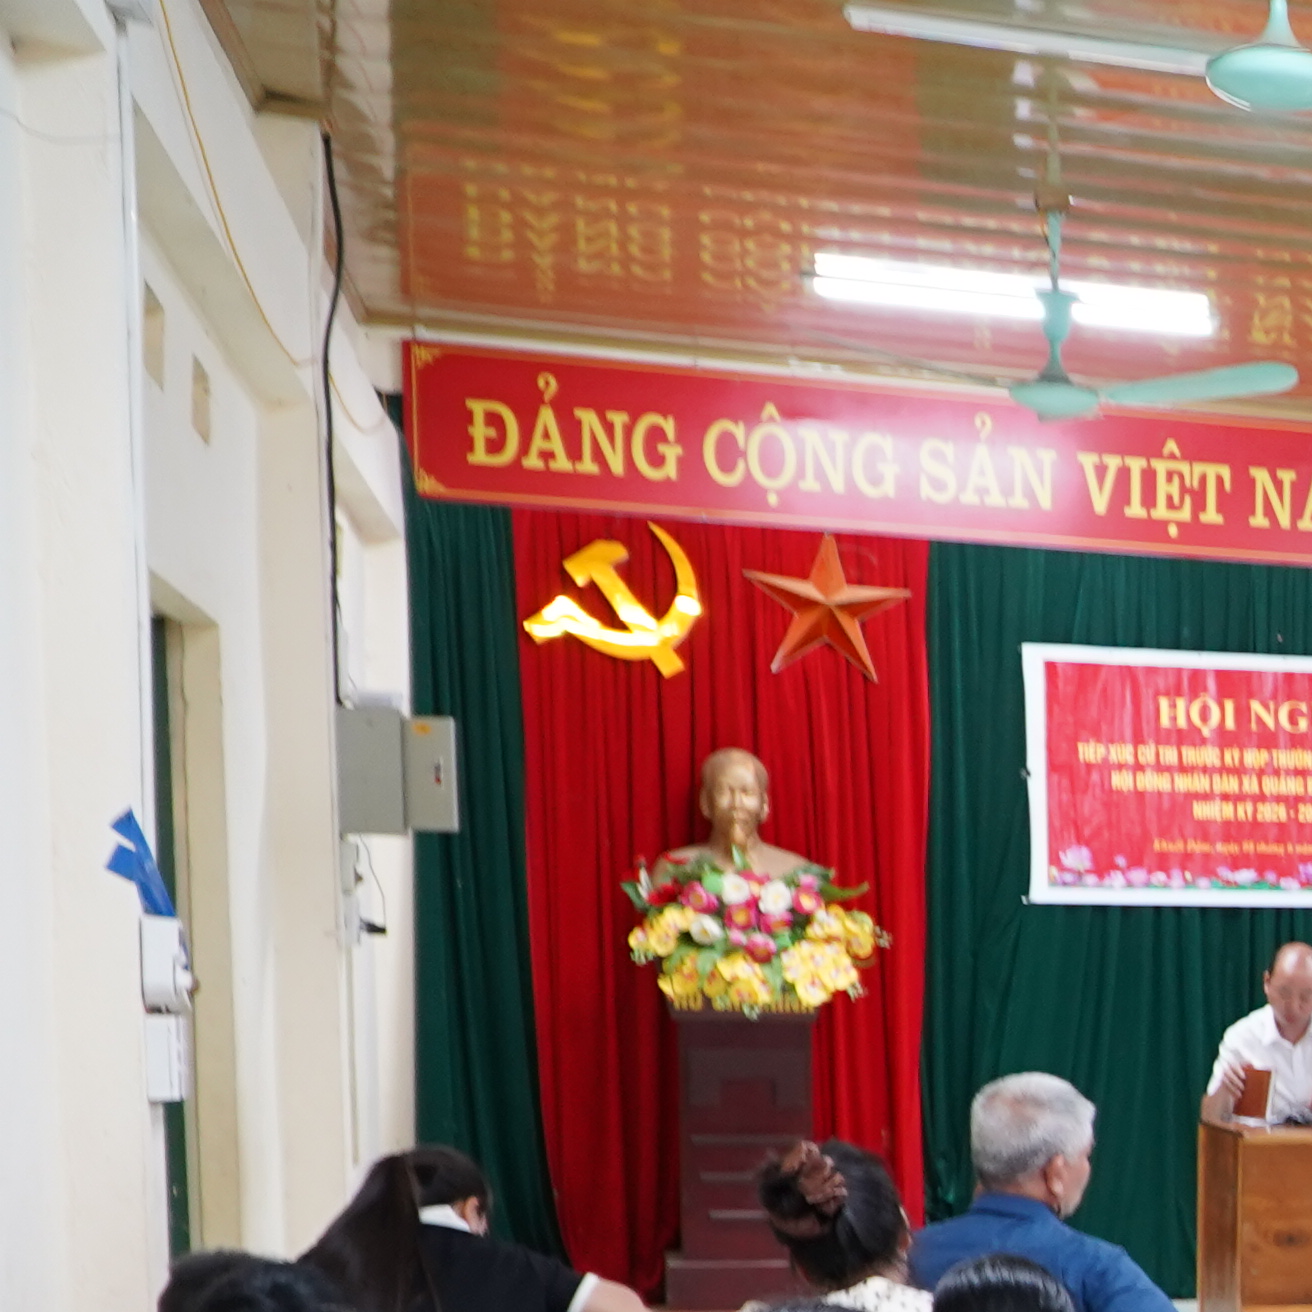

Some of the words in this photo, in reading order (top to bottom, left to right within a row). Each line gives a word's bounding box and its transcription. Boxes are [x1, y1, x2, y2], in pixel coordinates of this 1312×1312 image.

[465, 371, 683, 482] ĐẢNG
[702, 401, 899, 507] CỘNG
[919, 411, 1057, 511] SẢN
[1077, 438, 1231, 539] VIỆT
[1158, 693, 1236, 738] HỘI
